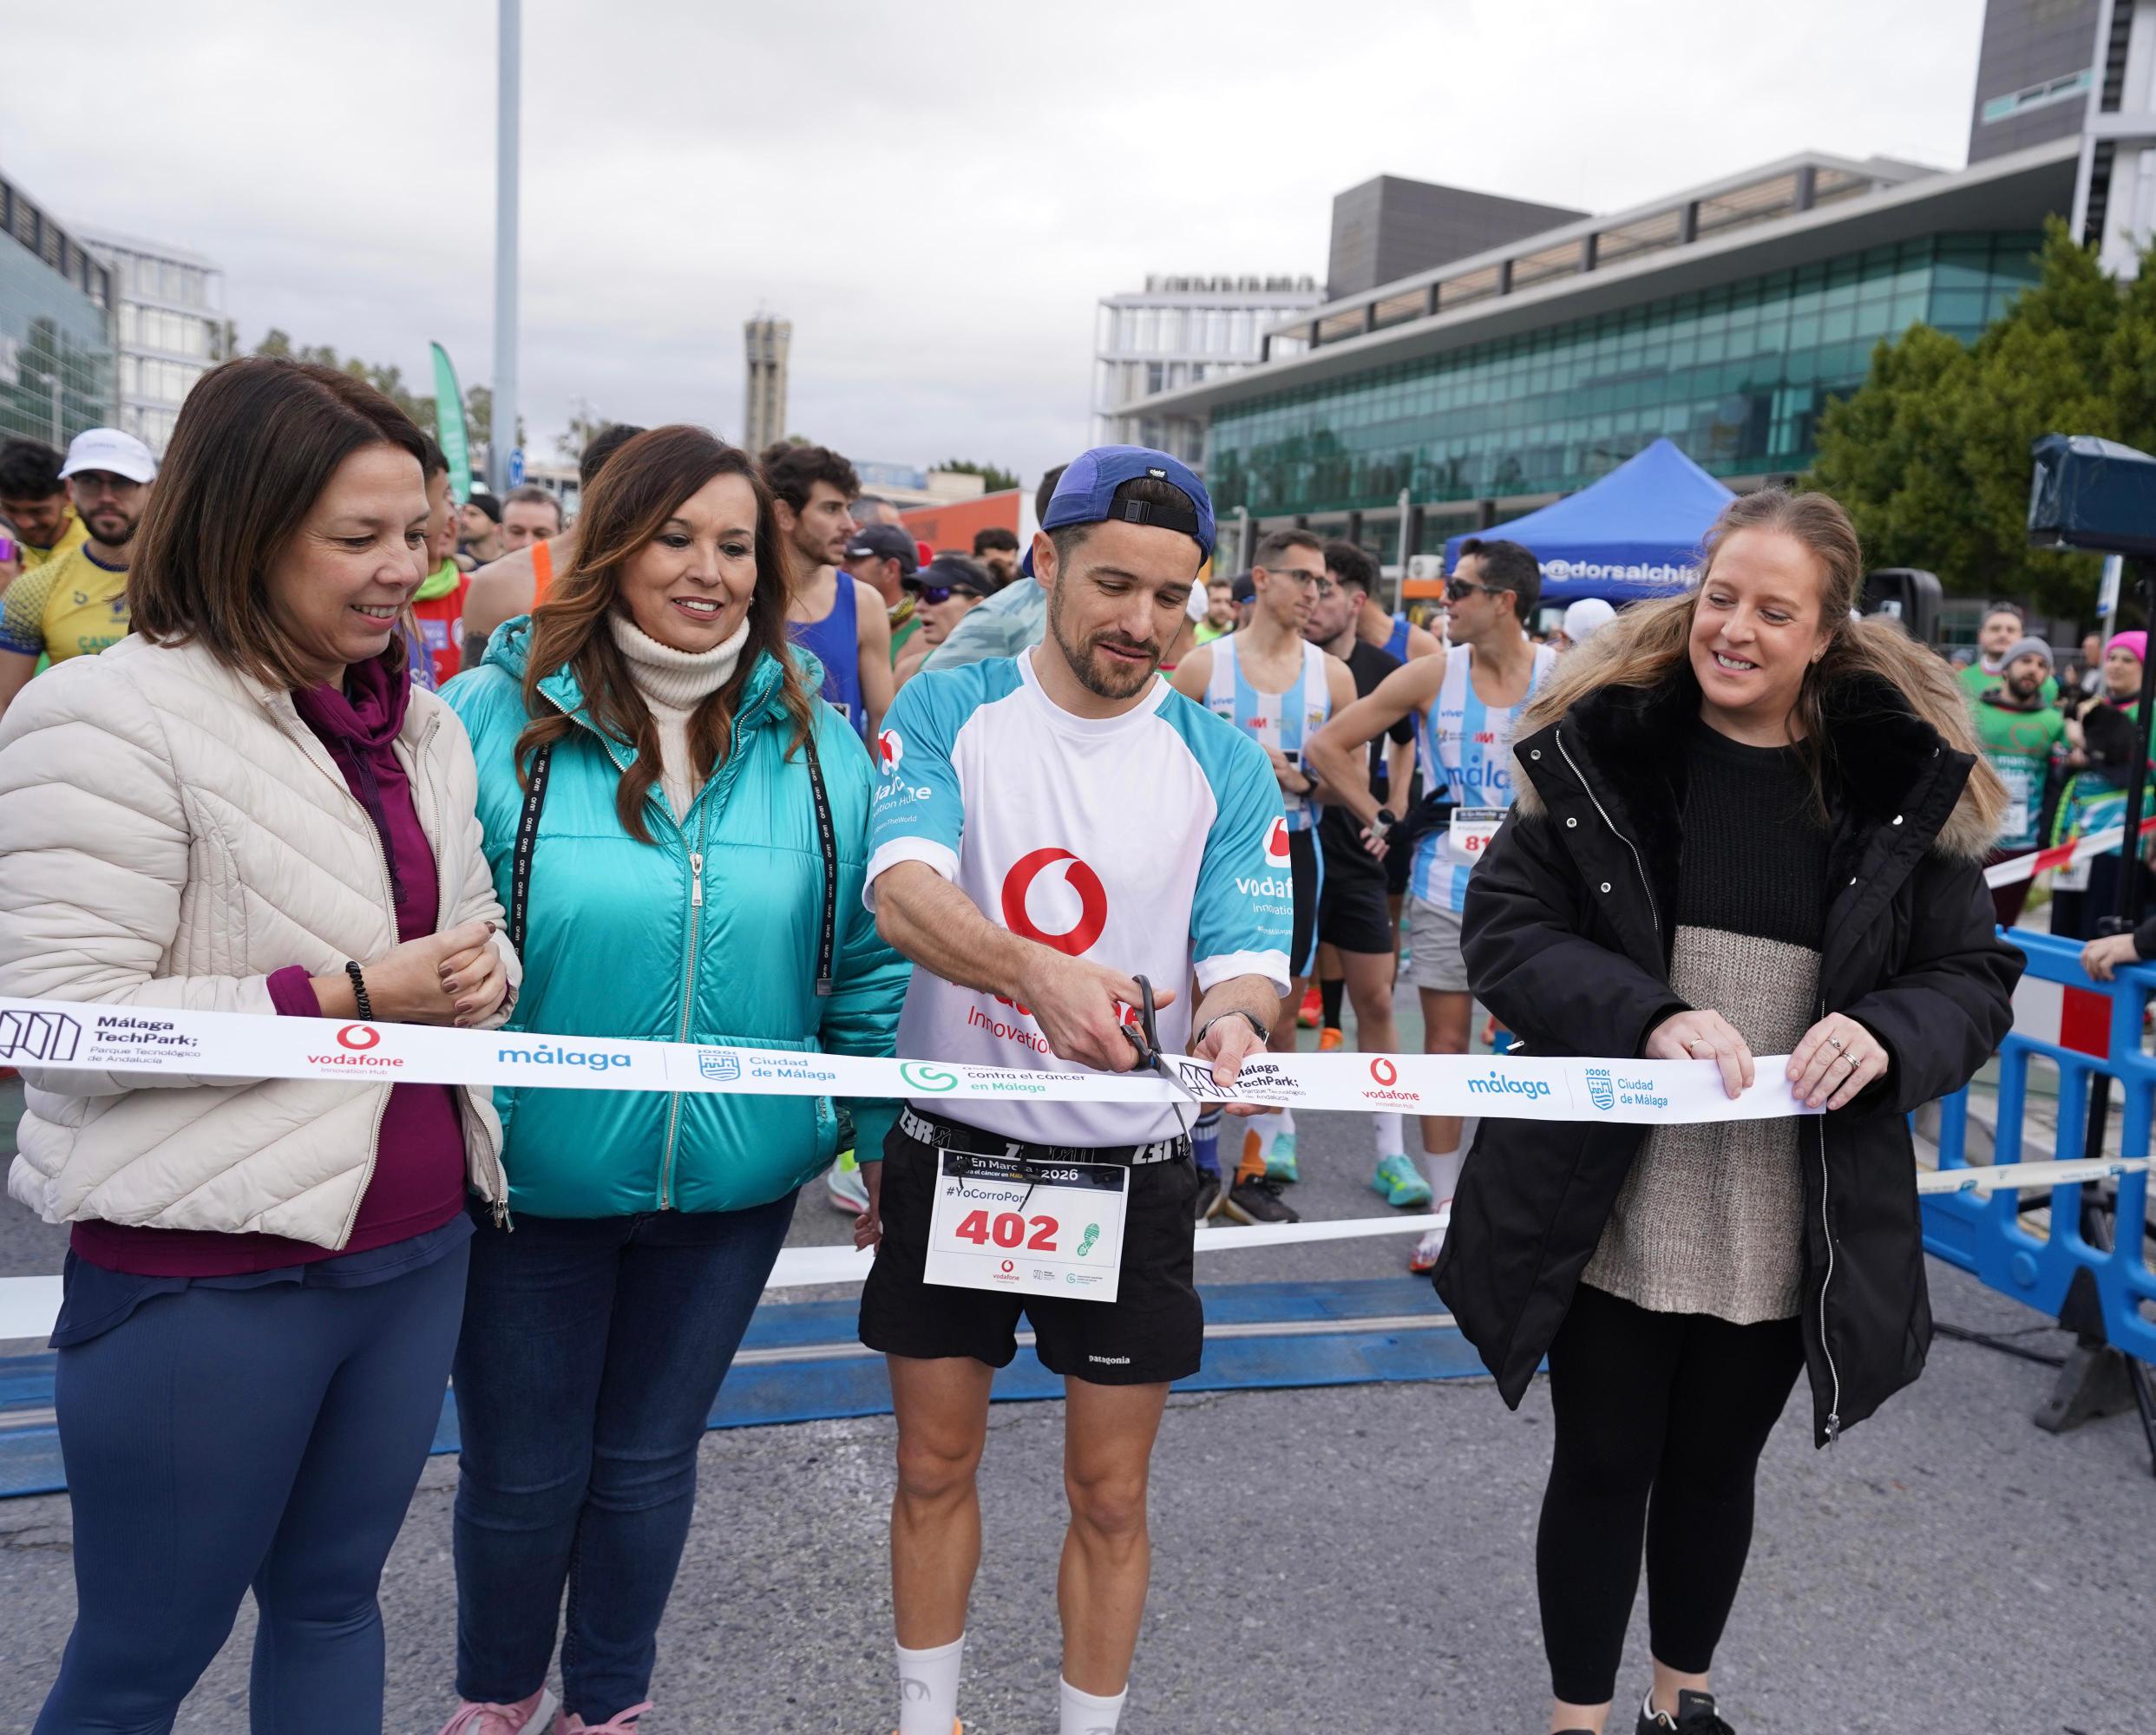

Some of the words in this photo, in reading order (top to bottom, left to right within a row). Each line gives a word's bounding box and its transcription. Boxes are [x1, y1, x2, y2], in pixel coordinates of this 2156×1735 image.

[97, 1016, 174, 1031] Málaga
[90, 1046, 131, 1056] Parque
[134, 1047, 201, 1057] Tecnológico
[106, 1056, 162, 1064] Andalucía
[307, 1053, 404, 1067] vodafone
[749, 1057, 809, 1067] Ciudad
[320, 1066, 367, 1075] Innovation
[751, 1067, 773, 1077] de
[777, 1068, 836, 1082] Málaga
[992, 1082, 1046, 1093] Málaga
[1617, 1078, 1654, 1090] Ciudad
[1361, 1089, 1420, 1101] vodafone
[1620, 1093, 1634, 1104] de
[1635, 1094, 1668, 1108] Málaga
[971, 1157, 986, 1168] En
[989, 1159, 1033, 1173] Marca
[1041, 1169, 1078, 1181] 2026
[946, 1186, 1026, 1203] #YoCorroPor
[955, 1209, 1059, 1252] 402
[993, 1273, 1020, 1281] vodafone
